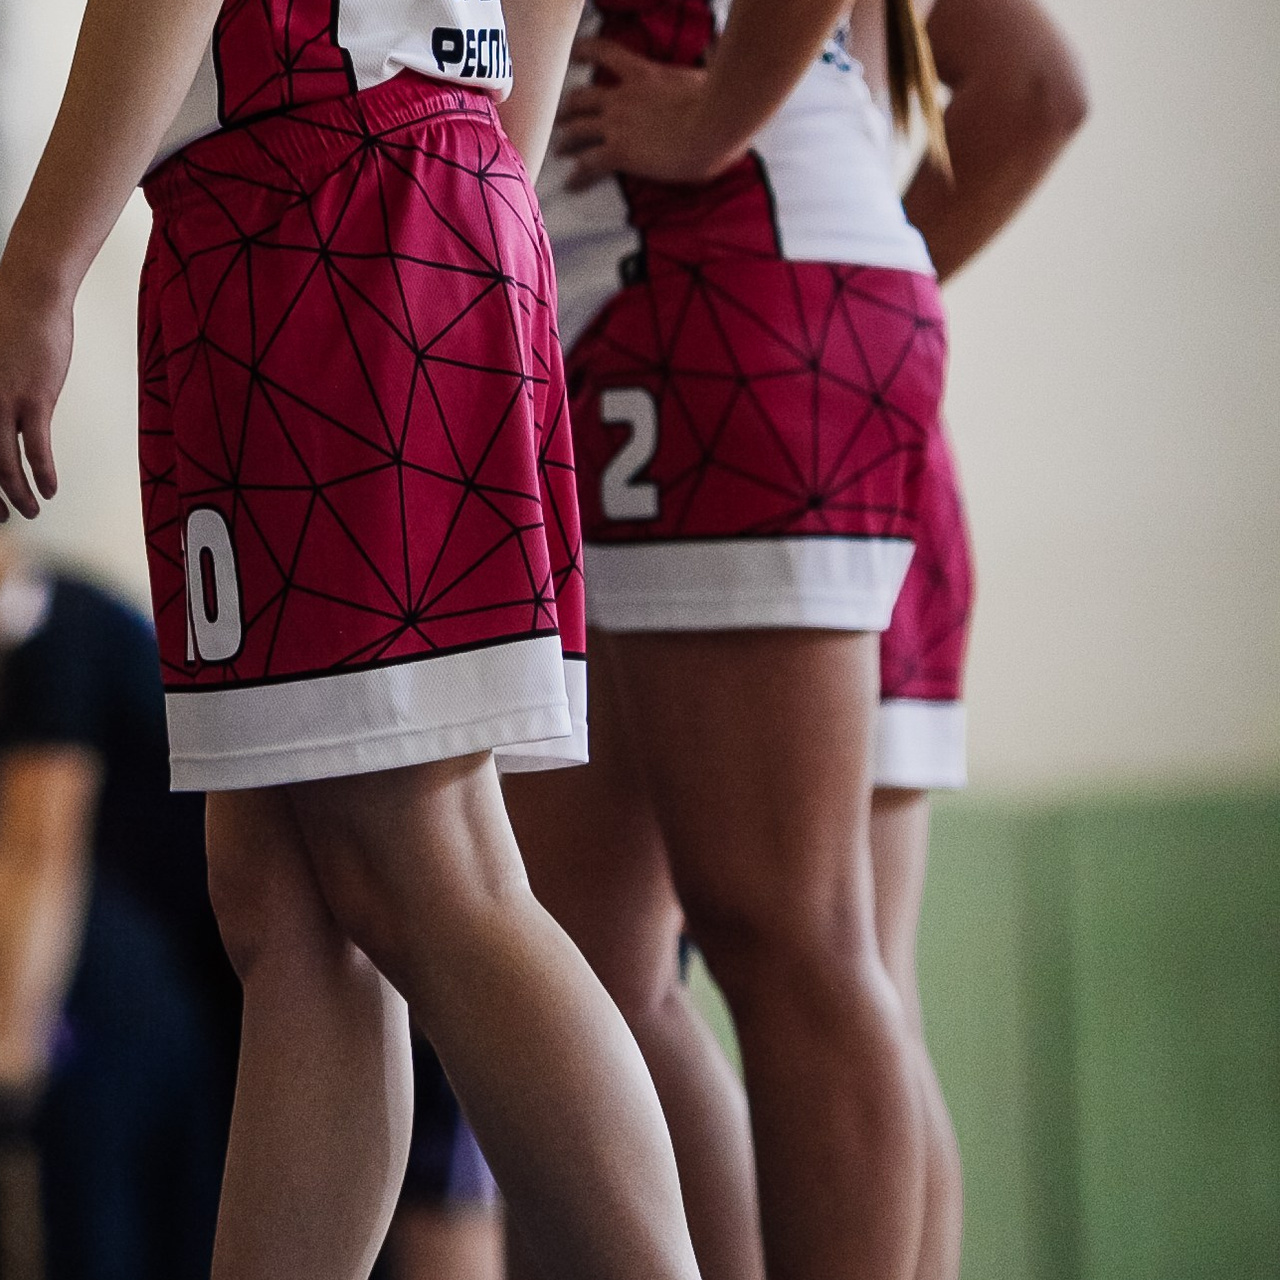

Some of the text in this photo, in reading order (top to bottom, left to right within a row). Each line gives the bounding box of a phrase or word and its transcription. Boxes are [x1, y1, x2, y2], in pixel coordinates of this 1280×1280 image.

[431, 27, 512, 78] РЕСПУ
[600, 388, 659, 520] 2
[181, 507, 242, 662] 0
